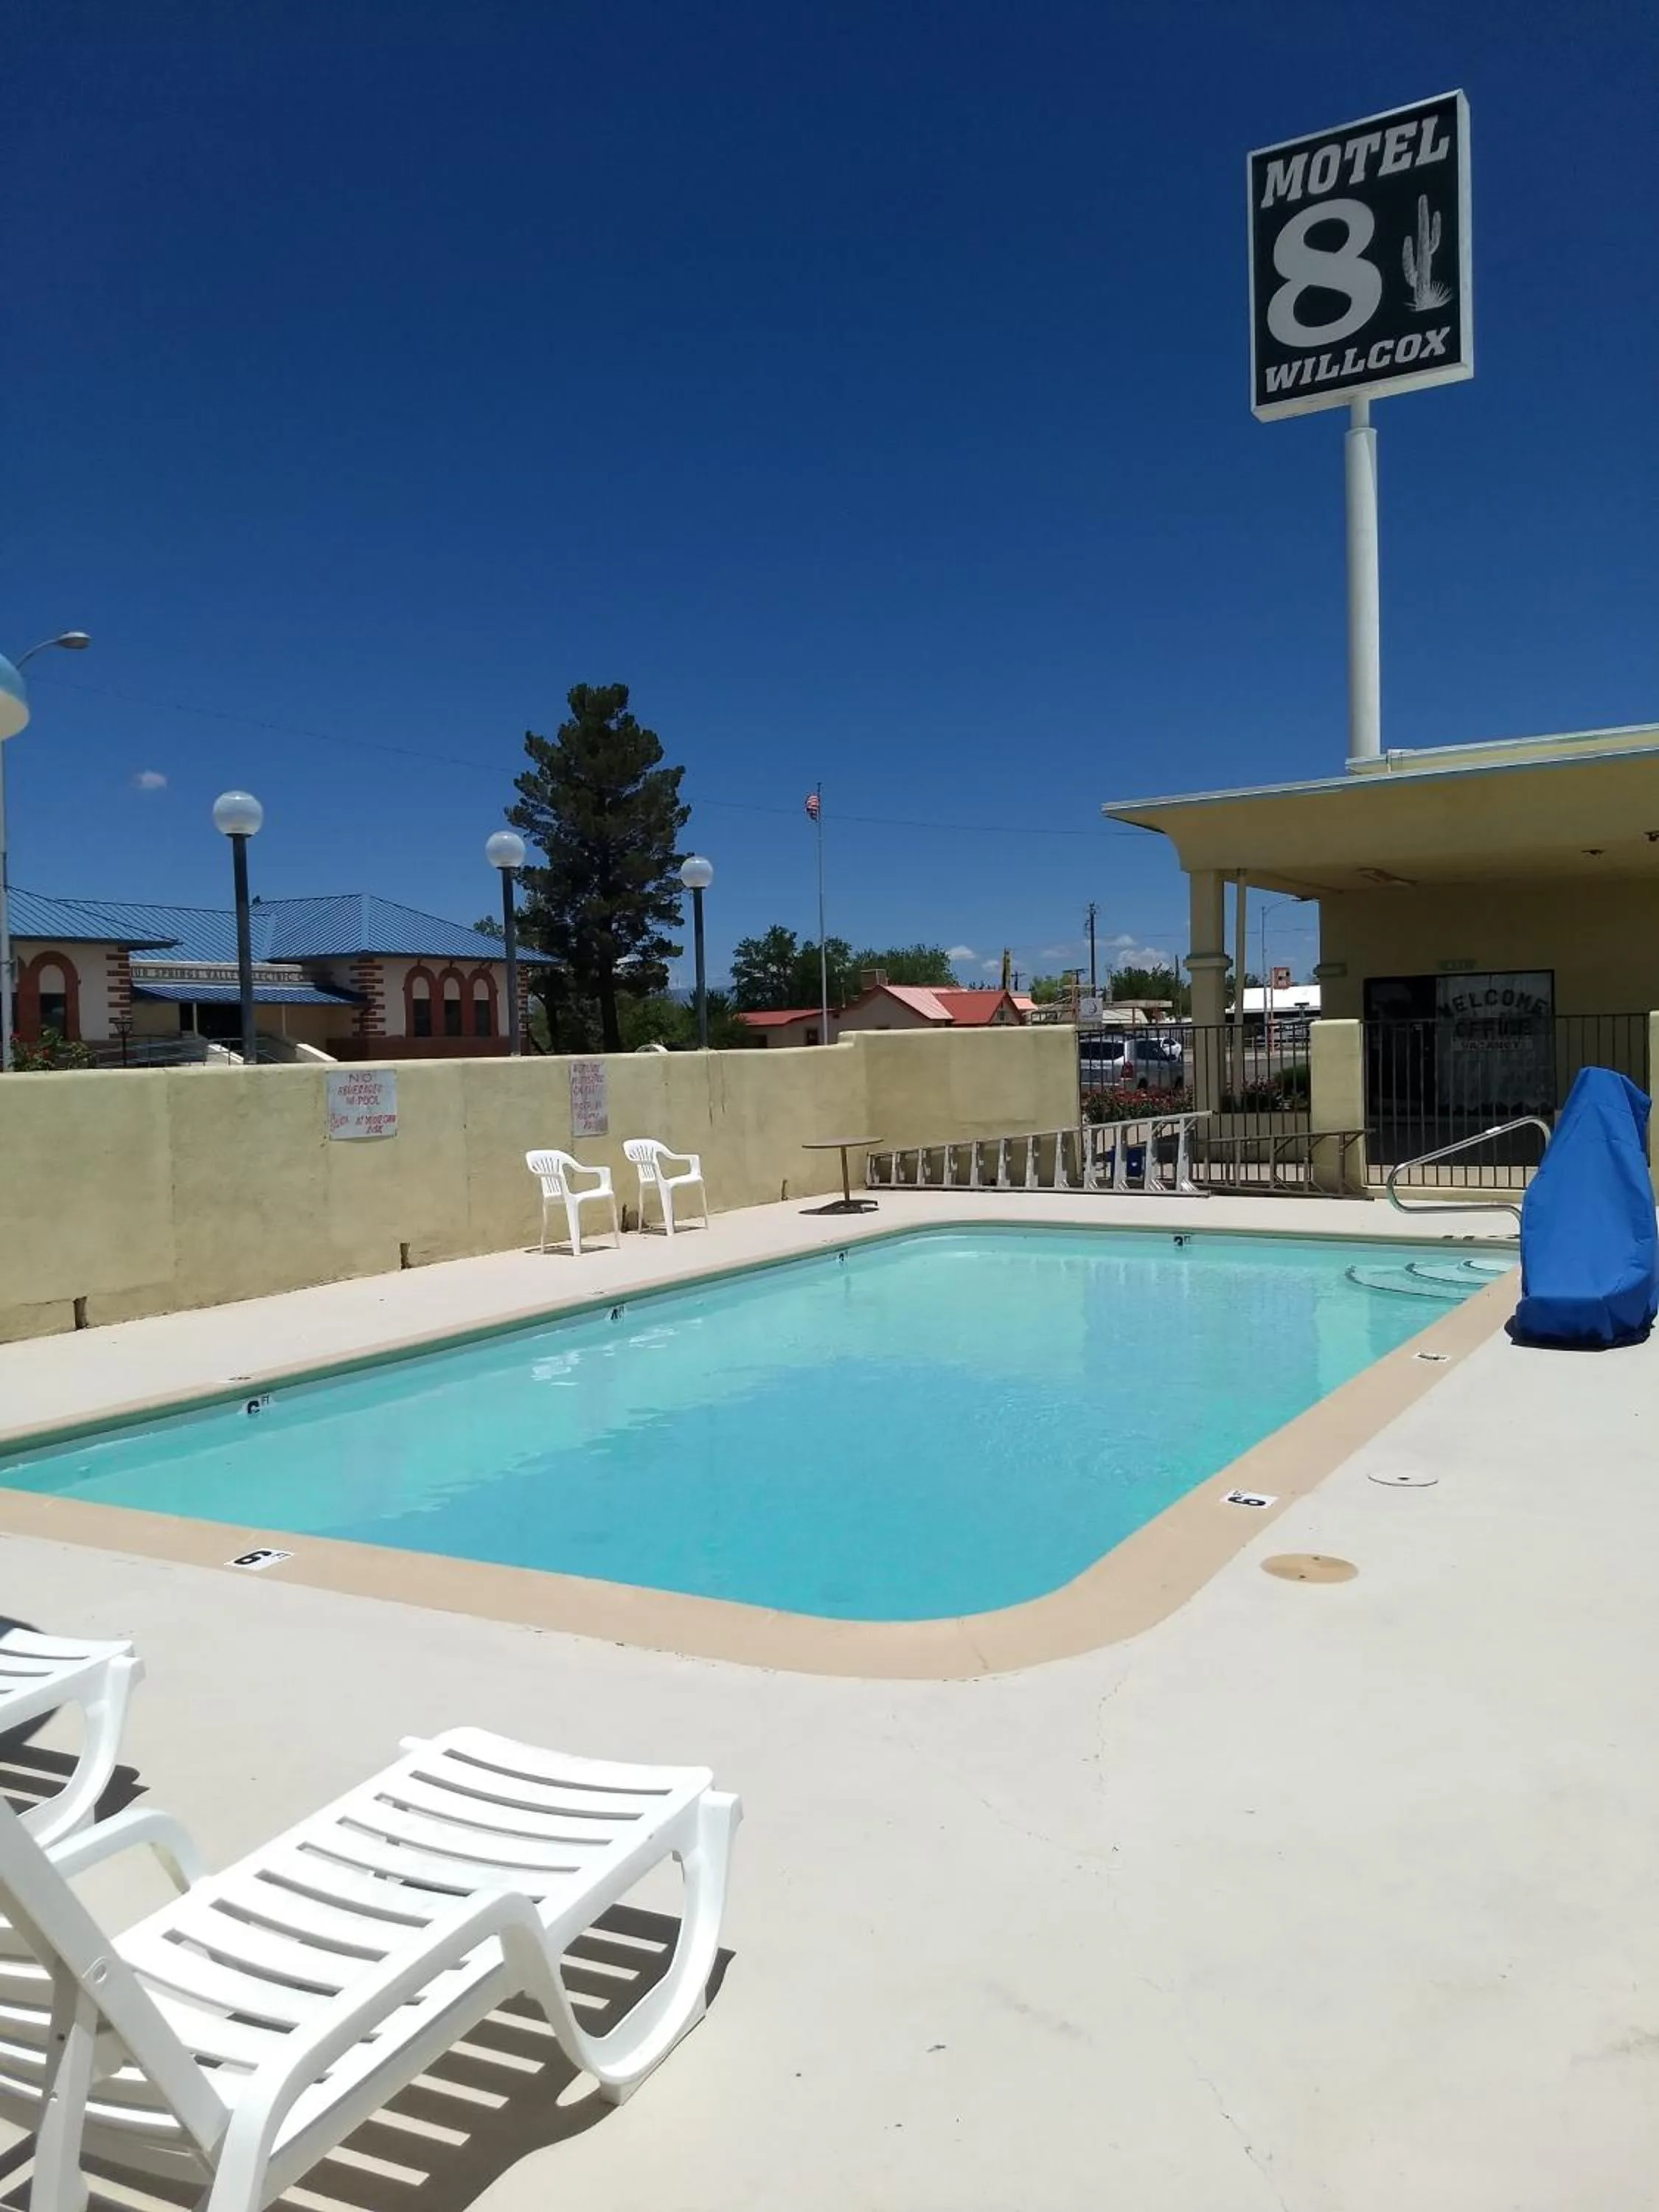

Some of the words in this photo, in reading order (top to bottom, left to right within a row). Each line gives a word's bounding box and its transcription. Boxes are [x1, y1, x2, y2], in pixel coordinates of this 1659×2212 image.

[1261, 114, 1450, 209] MOTEL
[1267, 198, 1382, 347] 8
[1265, 326, 1451, 393] WILLCOX
[1437, 989, 1548, 1017] WELCOME
[348, 1073, 372, 1083] NO
[234, 1551, 272, 1565] 6
